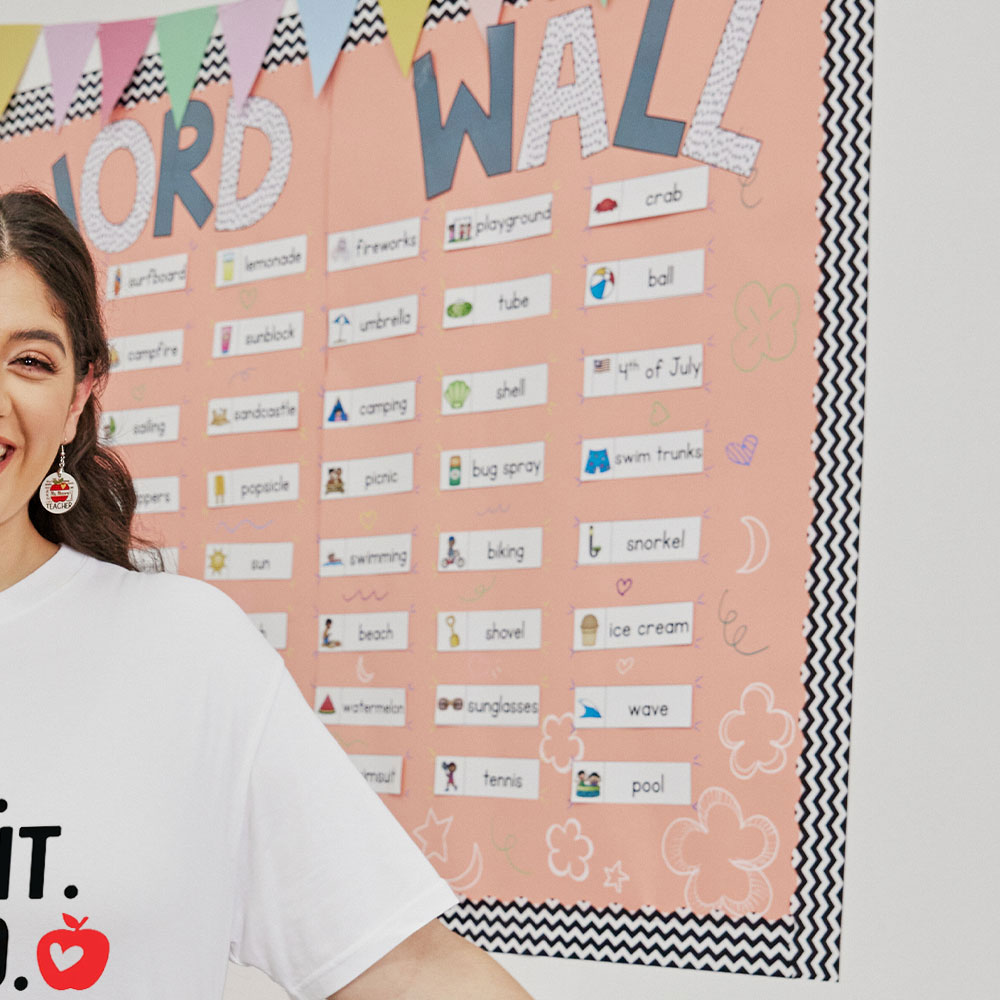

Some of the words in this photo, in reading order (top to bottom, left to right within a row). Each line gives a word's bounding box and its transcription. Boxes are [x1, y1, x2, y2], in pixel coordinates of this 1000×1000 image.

[52, 96, 293, 253] ORD
[413, 0, 763, 200] WALL
[645, 184, 682, 207] crab
[476, 202, 552, 237] playground
[355, 234, 417, 257] fireworks
[244, 251, 302, 271] lemonade
[128, 267, 187, 288] surfboard
[648, 265, 675, 287] ball
[498, 292, 529, 311] tube
[359, 309, 411, 332] umbrella
[245, 327, 295, 346] sunblock
[127, 341, 178, 363] campfire
[618, 362, 640, 380] 4th
[645, 358, 663, 379] of
[669, 356, 702, 379] July
[496, 378, 526, 400] shell
[234, 403, 295, 421] sandcastle
[359, 398, 408, 417] camping
[133, 418, 166, 437] sailing
[614, 451, 651, 466] swim
[657, 445, 702, 462] trunks
[364, 470, 398, 487] picnic
[472, 458, 497, 481] bug
[503, 456, 541, 478] spray
[241, 476, 290, 496] popsicle
[626, 529, 685, 551] snorkel
[350, 548, 408, 568] swimming
[487, 541, 525, 562] biking
[251, 558, 270, 570] sun
[358, 624, 394, 641] beach
[485, 620, 525, 640] shovel
[609, 623, 631, 638] ice
[638, 619, 689, 635] cream
[343, 700, 404, 714] watermelon
[468, 696, 538, 717] sunglasses
[628, 703, 669, 717] wave
[484, 772, 523, 789] tennis
[632, 774, 664, 797] pool
